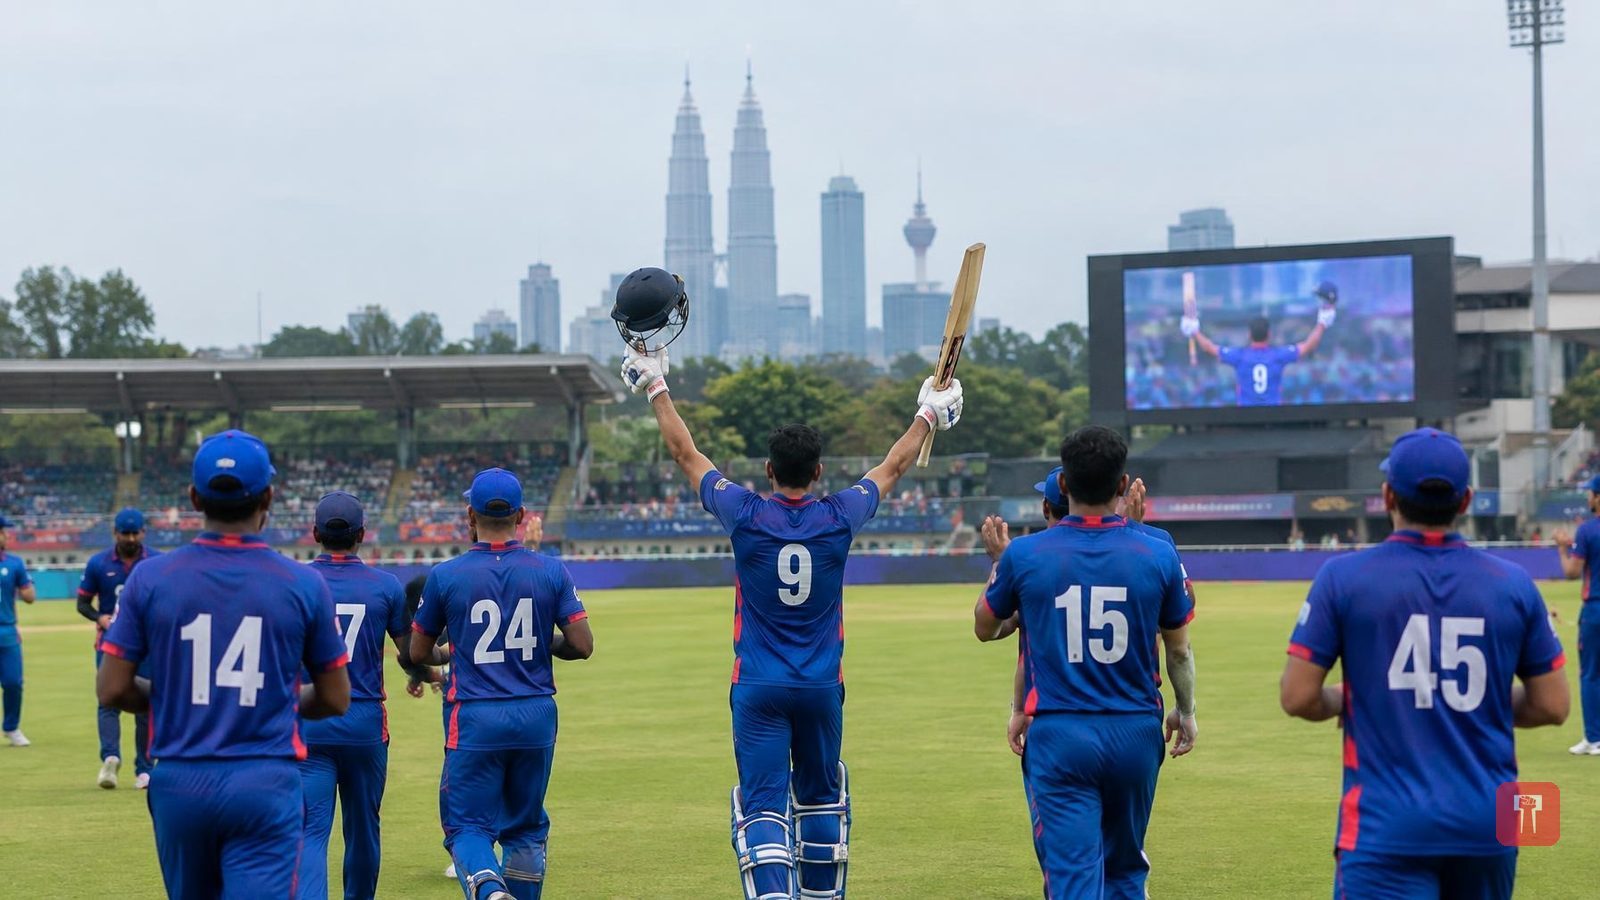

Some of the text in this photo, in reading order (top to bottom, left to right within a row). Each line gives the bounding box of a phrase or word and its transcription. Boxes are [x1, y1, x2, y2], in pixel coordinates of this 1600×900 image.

[1252, 363, 1268, 394] 9
[777, 543, 812, 606] 9
[336, 603, 366, 662] 7
[470, 598, 537, 665] 24
[1055, 585, 1129, 664] 15
[180, 613, 265, 707] 14
[1388, 614, 1487, 712] 45
